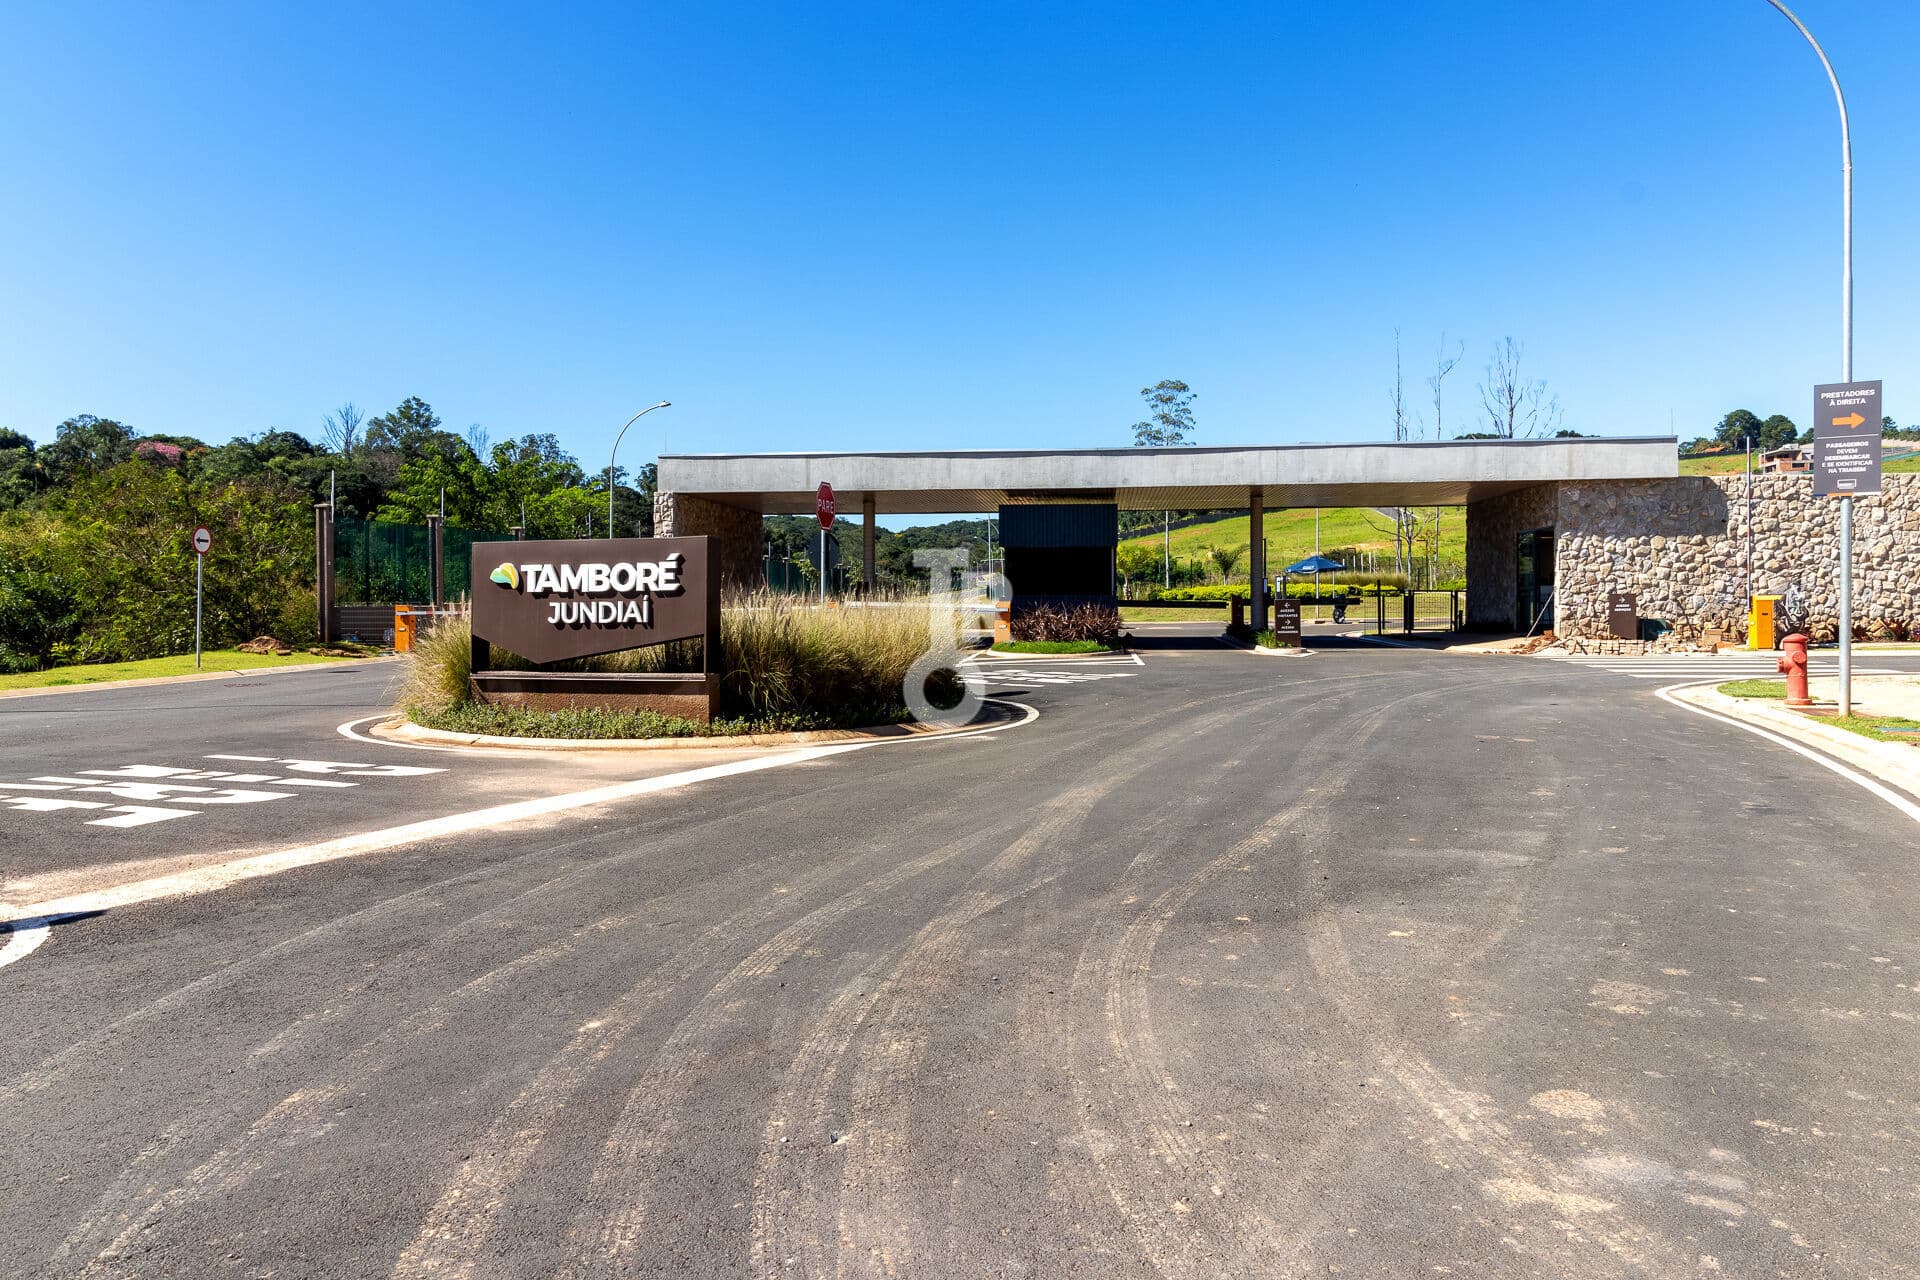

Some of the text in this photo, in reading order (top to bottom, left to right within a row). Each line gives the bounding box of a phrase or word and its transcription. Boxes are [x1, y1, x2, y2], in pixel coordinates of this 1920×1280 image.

[1820, 389, 1876, 399] PRESTADORES
[1836, 398, 1867, 406] DIREITA
[1825, 441, 1869, 449] PASSAGEIROS
[1824, 454, 1871, 462] DESEMBARCAR
[1835, 460, 1873, 468] IDENTIFICAR
[817, 499, 834, 514] PARE
[520, 552, 681, 593] TAMBORÉ
[547, 595, 649, 624] JUNDIAÍ
